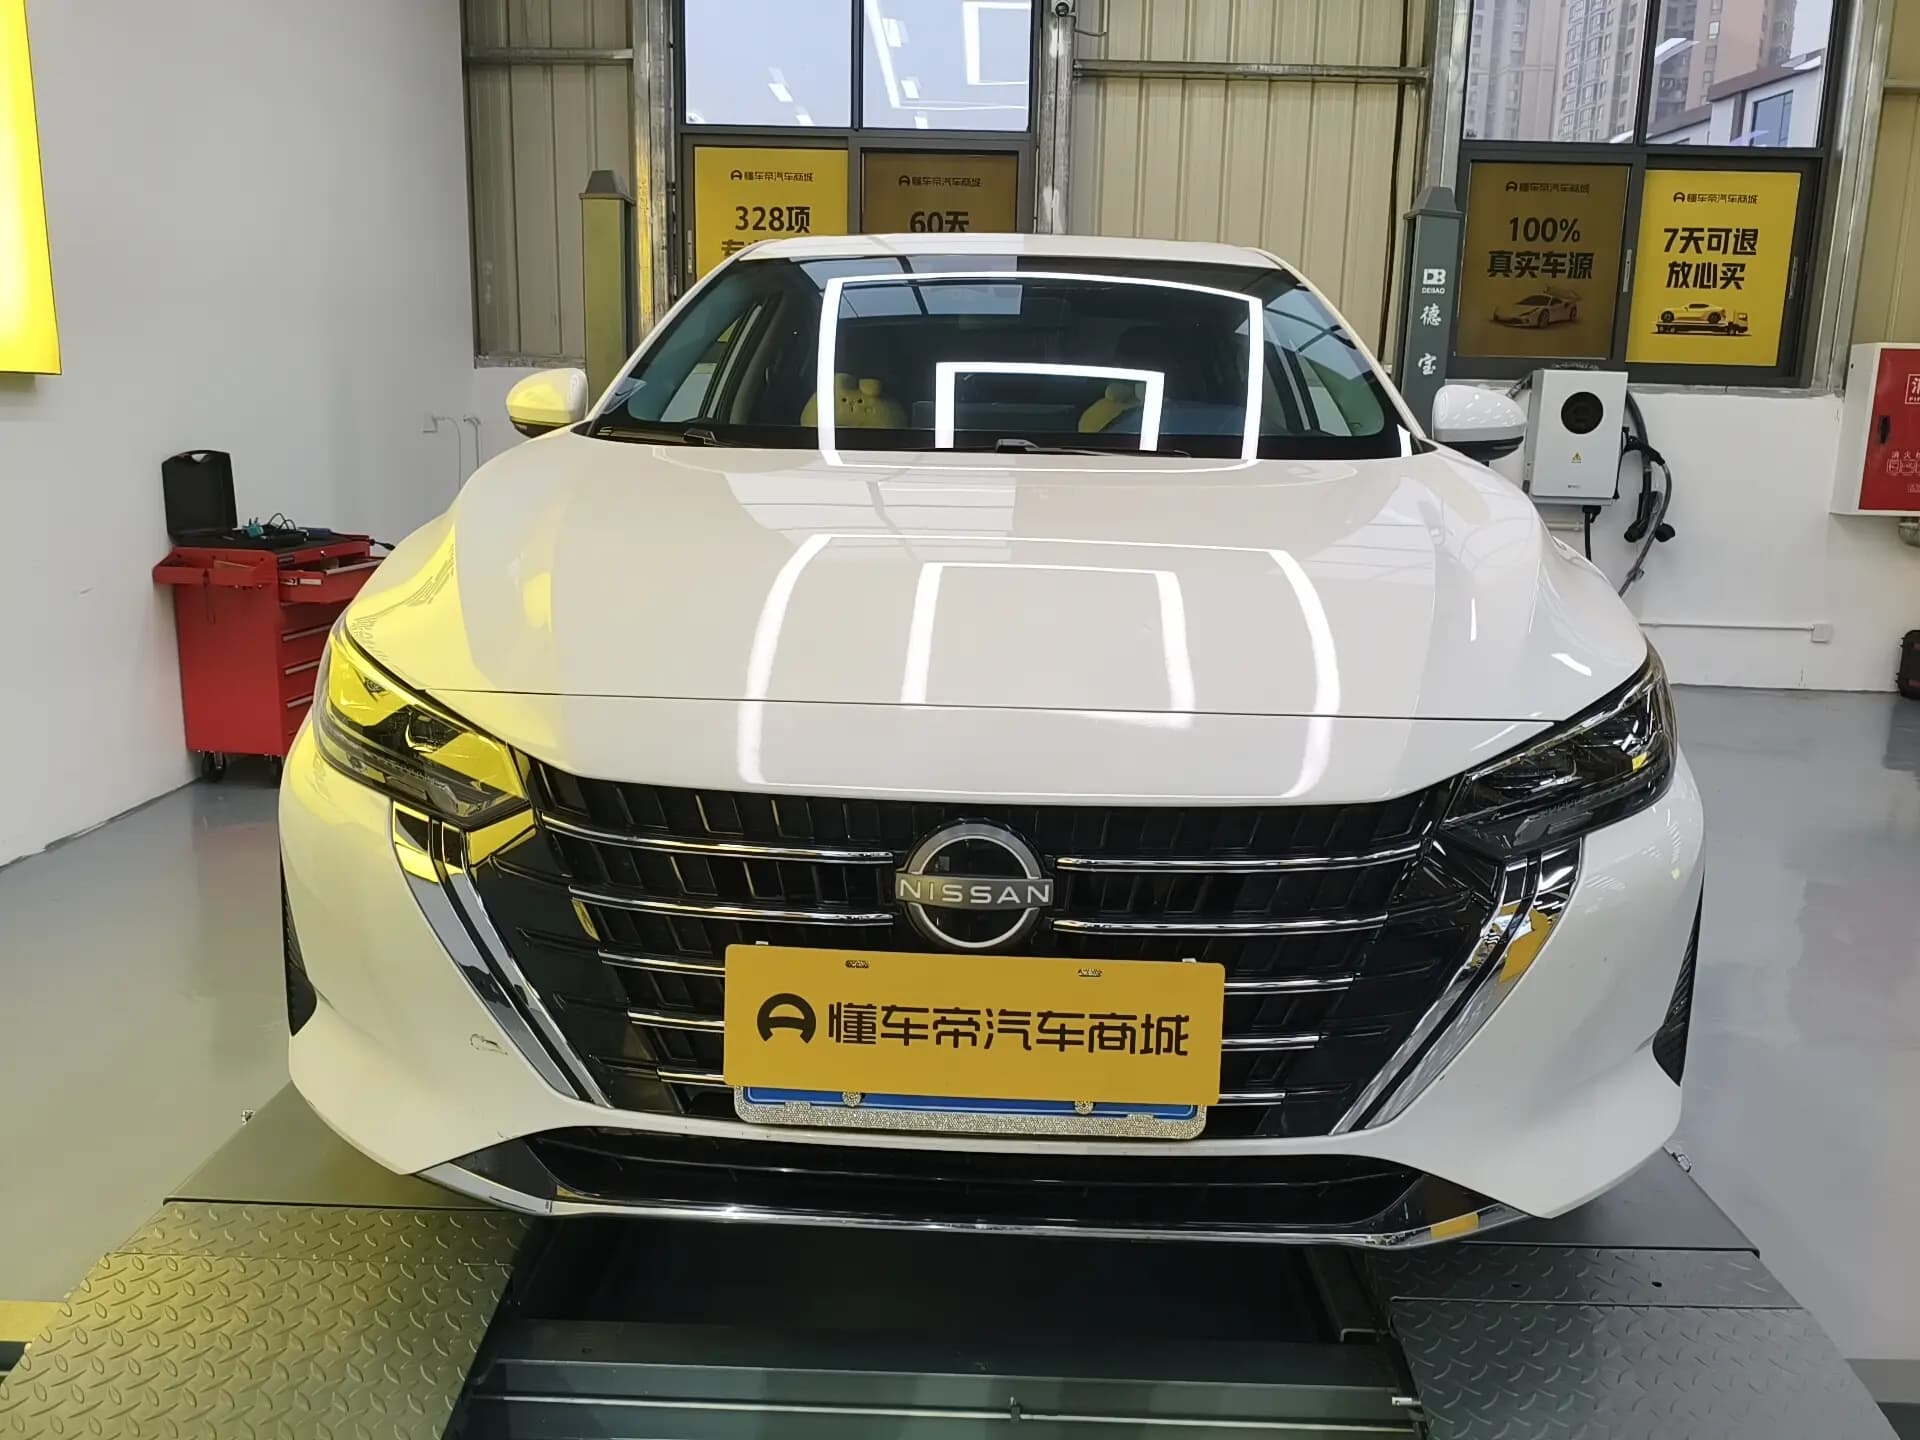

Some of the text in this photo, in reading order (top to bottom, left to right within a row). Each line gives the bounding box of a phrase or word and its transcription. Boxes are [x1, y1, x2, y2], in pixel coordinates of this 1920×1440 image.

[735, 205, 811, 233] 328项
[910, 210, 970, 232] 60天
[1509, 216, 1581, 243] 100%
[1663, 226, 1759, 256] 7天可退
[1487, 250, 1595, 280] 真实车源
[1665, 260, 1746, 291] 放心买
[1421, 287, 1445, 295] DEBAO
[900, 879, 1050, 904] NISSAN
[827, 1000, 1190, 1057] 懂车帝汽车商城
